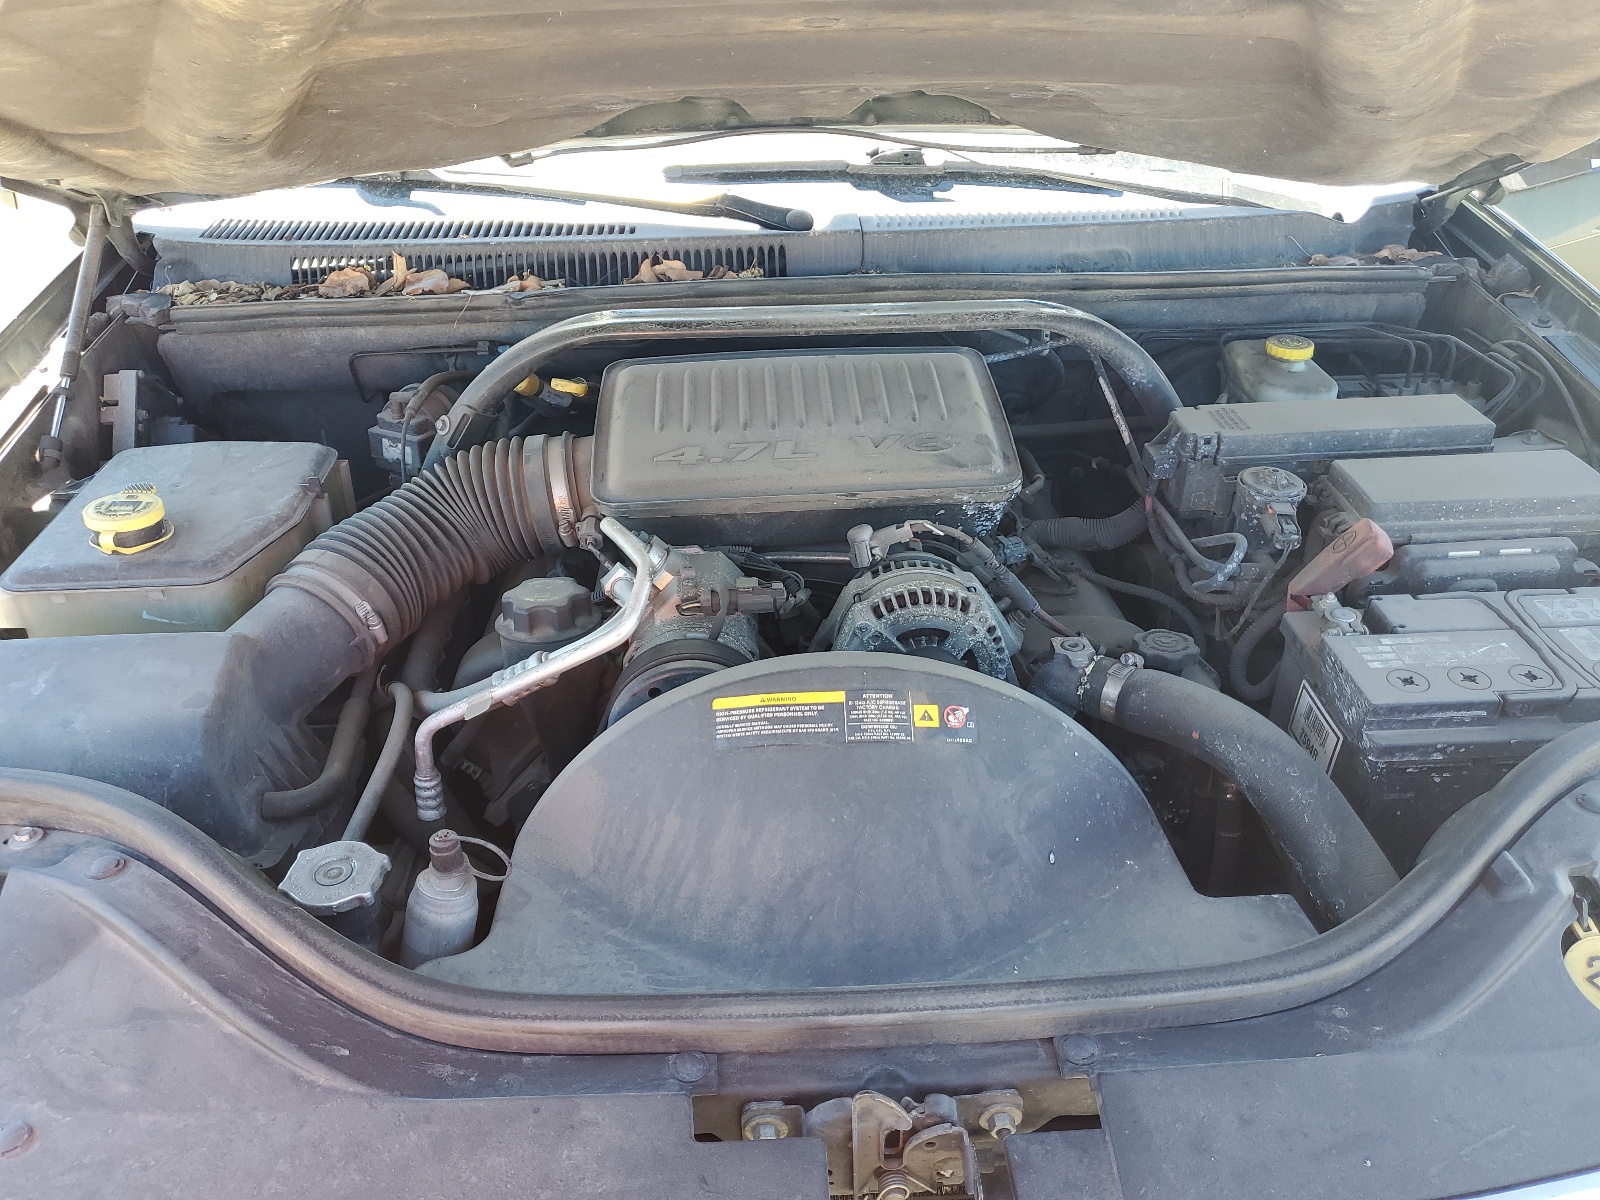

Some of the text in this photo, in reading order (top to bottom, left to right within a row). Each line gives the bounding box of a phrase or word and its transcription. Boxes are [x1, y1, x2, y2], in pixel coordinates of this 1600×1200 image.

[653, 432, 955, 465] 4.7L V8
[715, 708, 755, 717] HIGH-PRESSURE
